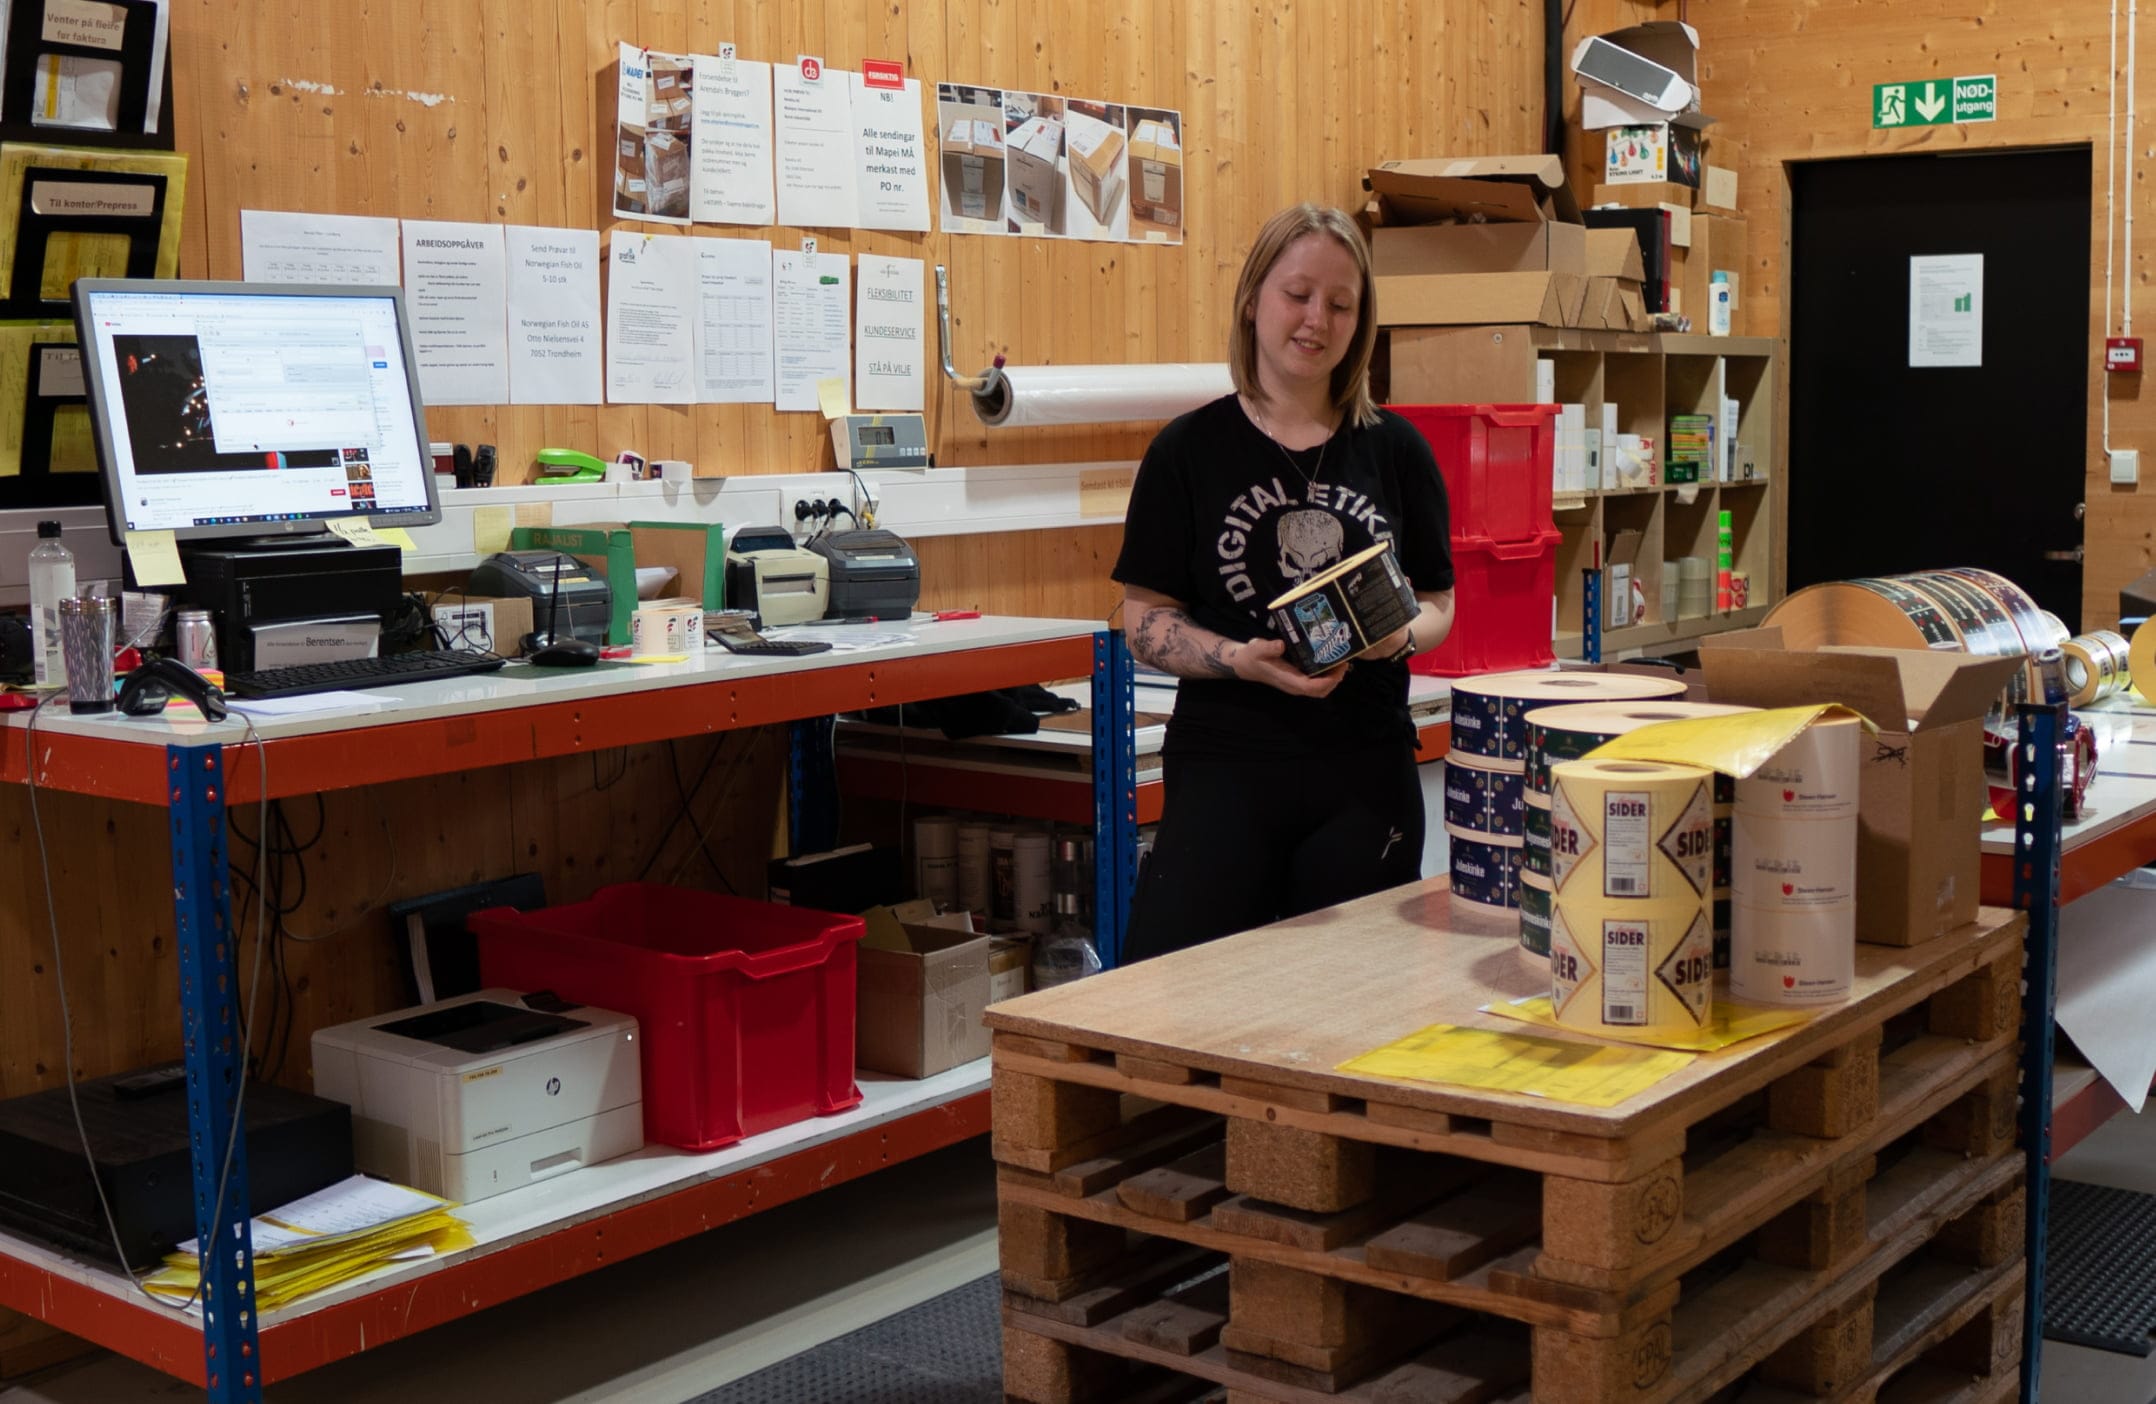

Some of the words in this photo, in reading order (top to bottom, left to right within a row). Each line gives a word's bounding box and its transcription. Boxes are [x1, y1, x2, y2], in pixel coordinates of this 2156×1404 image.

[880, 92, 894, 102] NB!
[1957, 84, 1993, 99] NØD-
[1956, 101, 1993, 114] utgang
[863, 128, 878, 138] Alle
[879, 130, 915, 143] sendingar
[866, 147, 874, 155] til
[875, 147, 900, 159] Mapei
[901, 146, 915, 158] MÅ
[866, 164, 898, 174] merkast
[899, 166, 916, 176] med
[880, 182, 892, 192] PO
[893, 184, 904, 193] nr.
[49, 199, 62, 208] Til
[416, 238, 484, 249] ARBEIDSOPPGÅVER
[531, 245, 547, 253] Send
[525, 259, 559, 270] Norwegian
[560, 261, 573, 269] Fish
[573, 261, 582, 270] Oil
[868, 287, 913, 301] FLEKSIBILITET
[521, 319, 557, 330] Norwegian
[557, 320, 570, 328] Fish
[571, 321, 580, 329] Oil
[527, 334, 541, 343] Otto
[863, 325, 916, 339] KUNDESERVICE
[547, 350, 582, 359] Trondheim
[868, 361, 881, 375] STÅ
[882, 361, 892, 375] PÅ
[893, 363, 912, 376] VILJE
[533, 532, 582, 547] RAJALIST
[1217, 477, 1299, 602] DIGITAL
[306, 636, 345, 647] Berentsen
[1511, 797, 1524, 812] Ju
[1609, 802, 1647, 817] SIDER
[1551, 828, 1580, 856] DER
[1677, 829, 1713, 857] SIDE
[1607, 931, 1645, 946] SIDER
[1551, 954, 1579, 983] DER
[1675, 957, 1713, 986] SIDE
